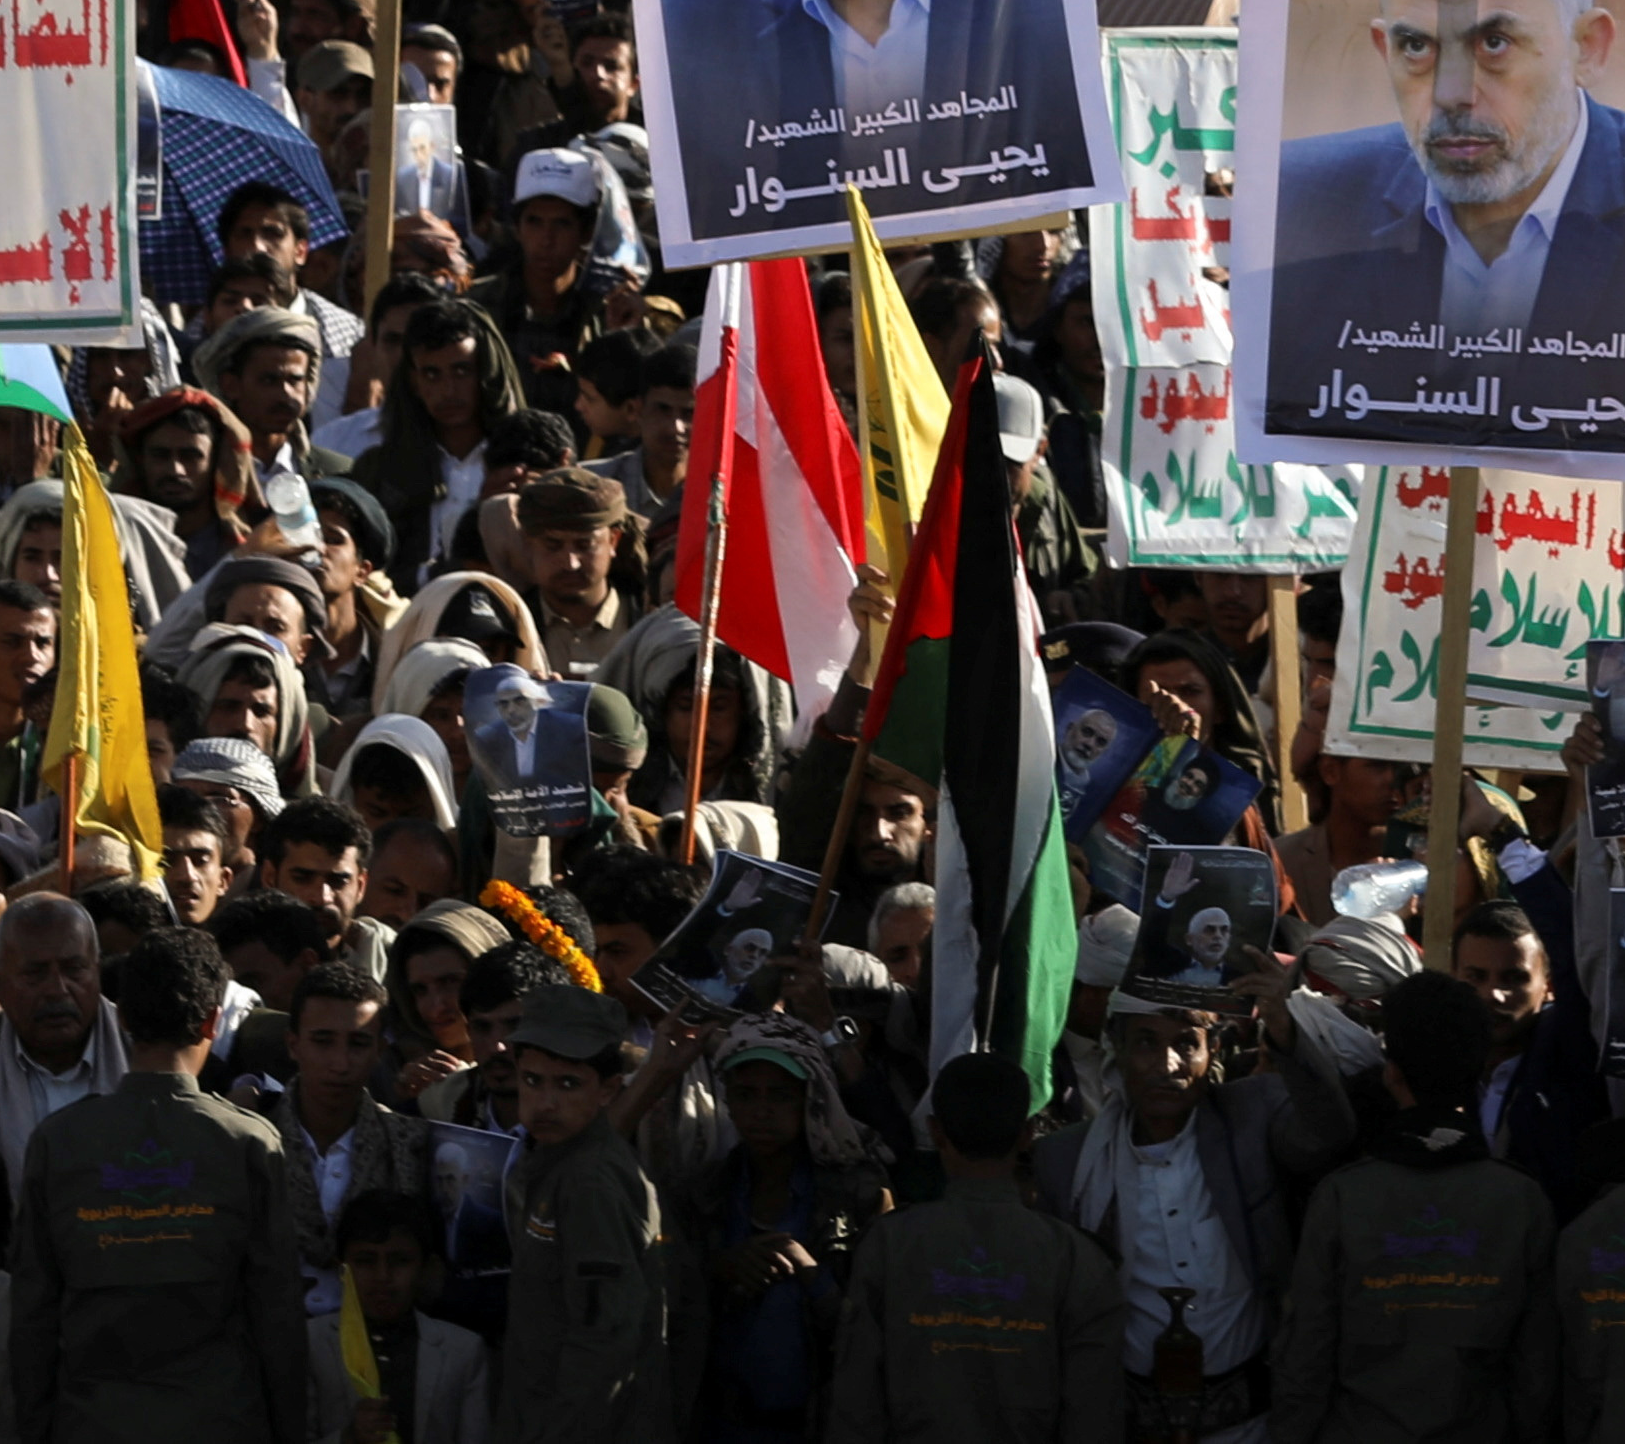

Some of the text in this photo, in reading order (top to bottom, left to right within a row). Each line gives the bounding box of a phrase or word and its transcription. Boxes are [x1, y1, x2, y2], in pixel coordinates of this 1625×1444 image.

[852, 98, 920, 137] الكبير
[926, 85, 1018, 120] المجاهد
[729, 142, 1050, 217] يحيى السنوار
[1449, 328, 1522, 359] الكبير
[1308, 368, 1500, 420] السنوار
[1141, 452, 1275, 542] للإسلام
[1477, 491, 1596, 556] اليهود
